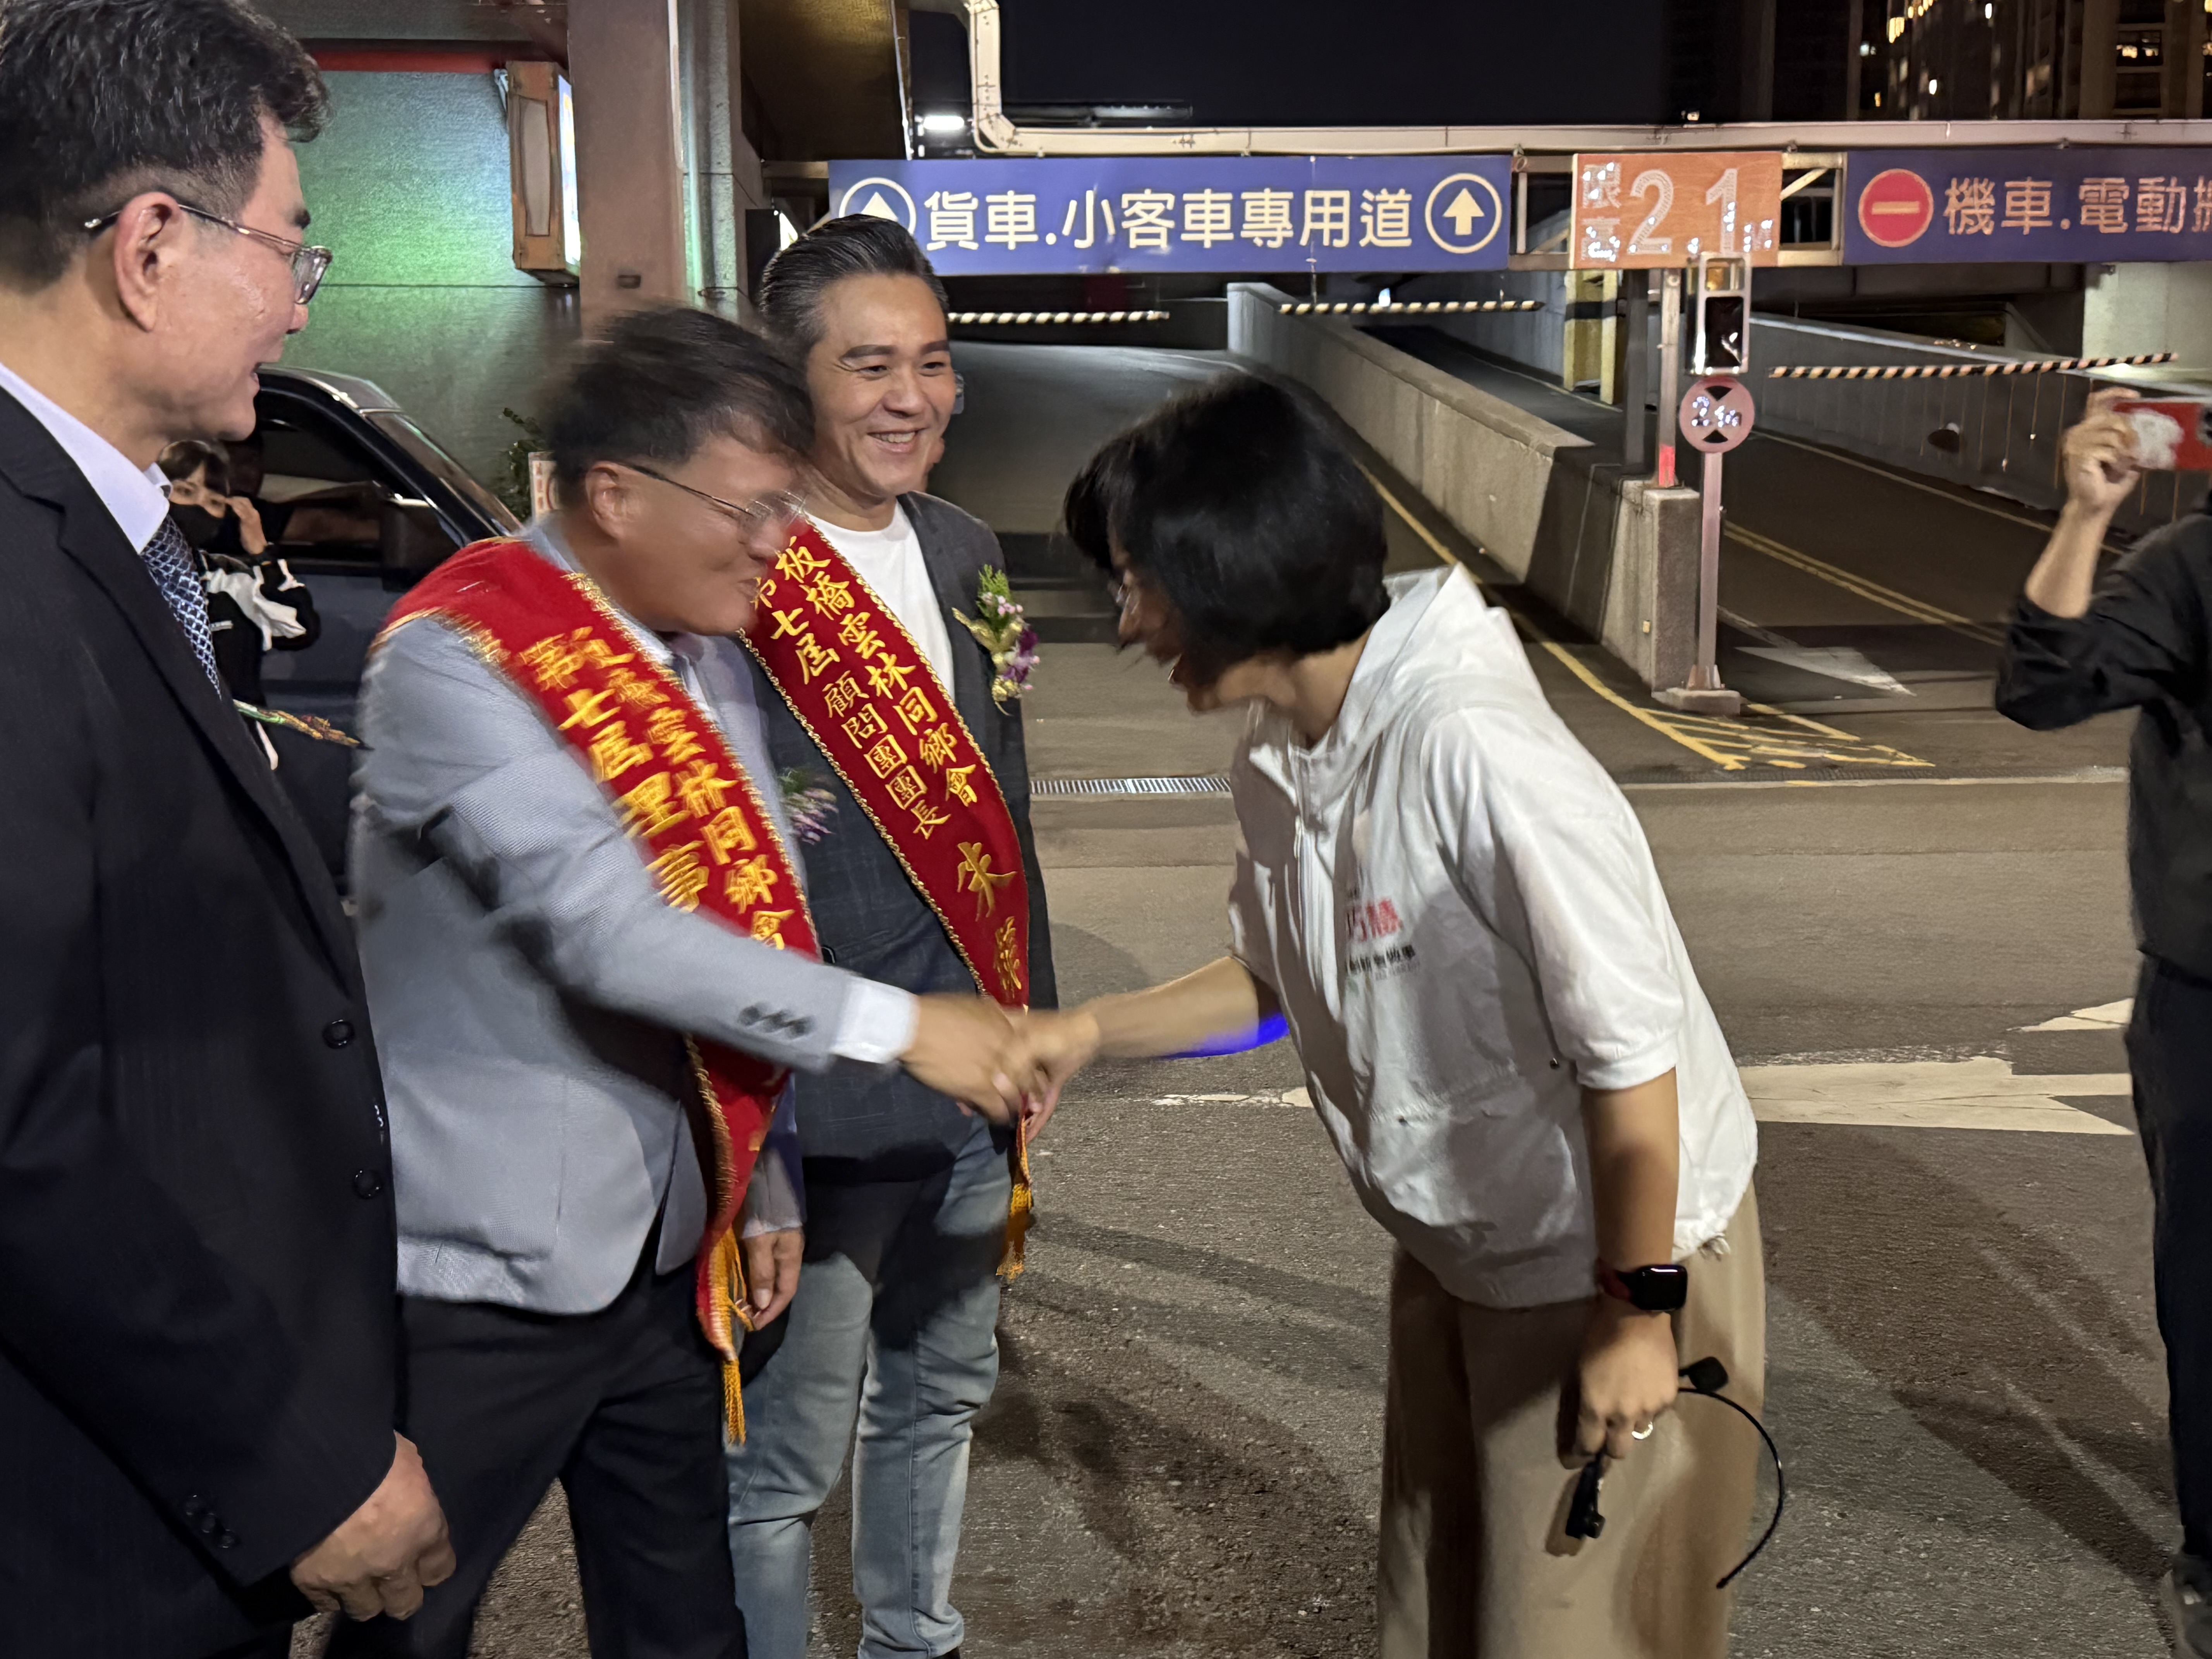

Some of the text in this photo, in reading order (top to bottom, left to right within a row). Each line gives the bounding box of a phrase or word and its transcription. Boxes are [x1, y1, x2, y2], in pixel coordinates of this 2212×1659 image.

[924, 188, 1412, 250] 貨車.小客車專用道
[775, 536, 977, 807] 板橋雲林同鄉會
